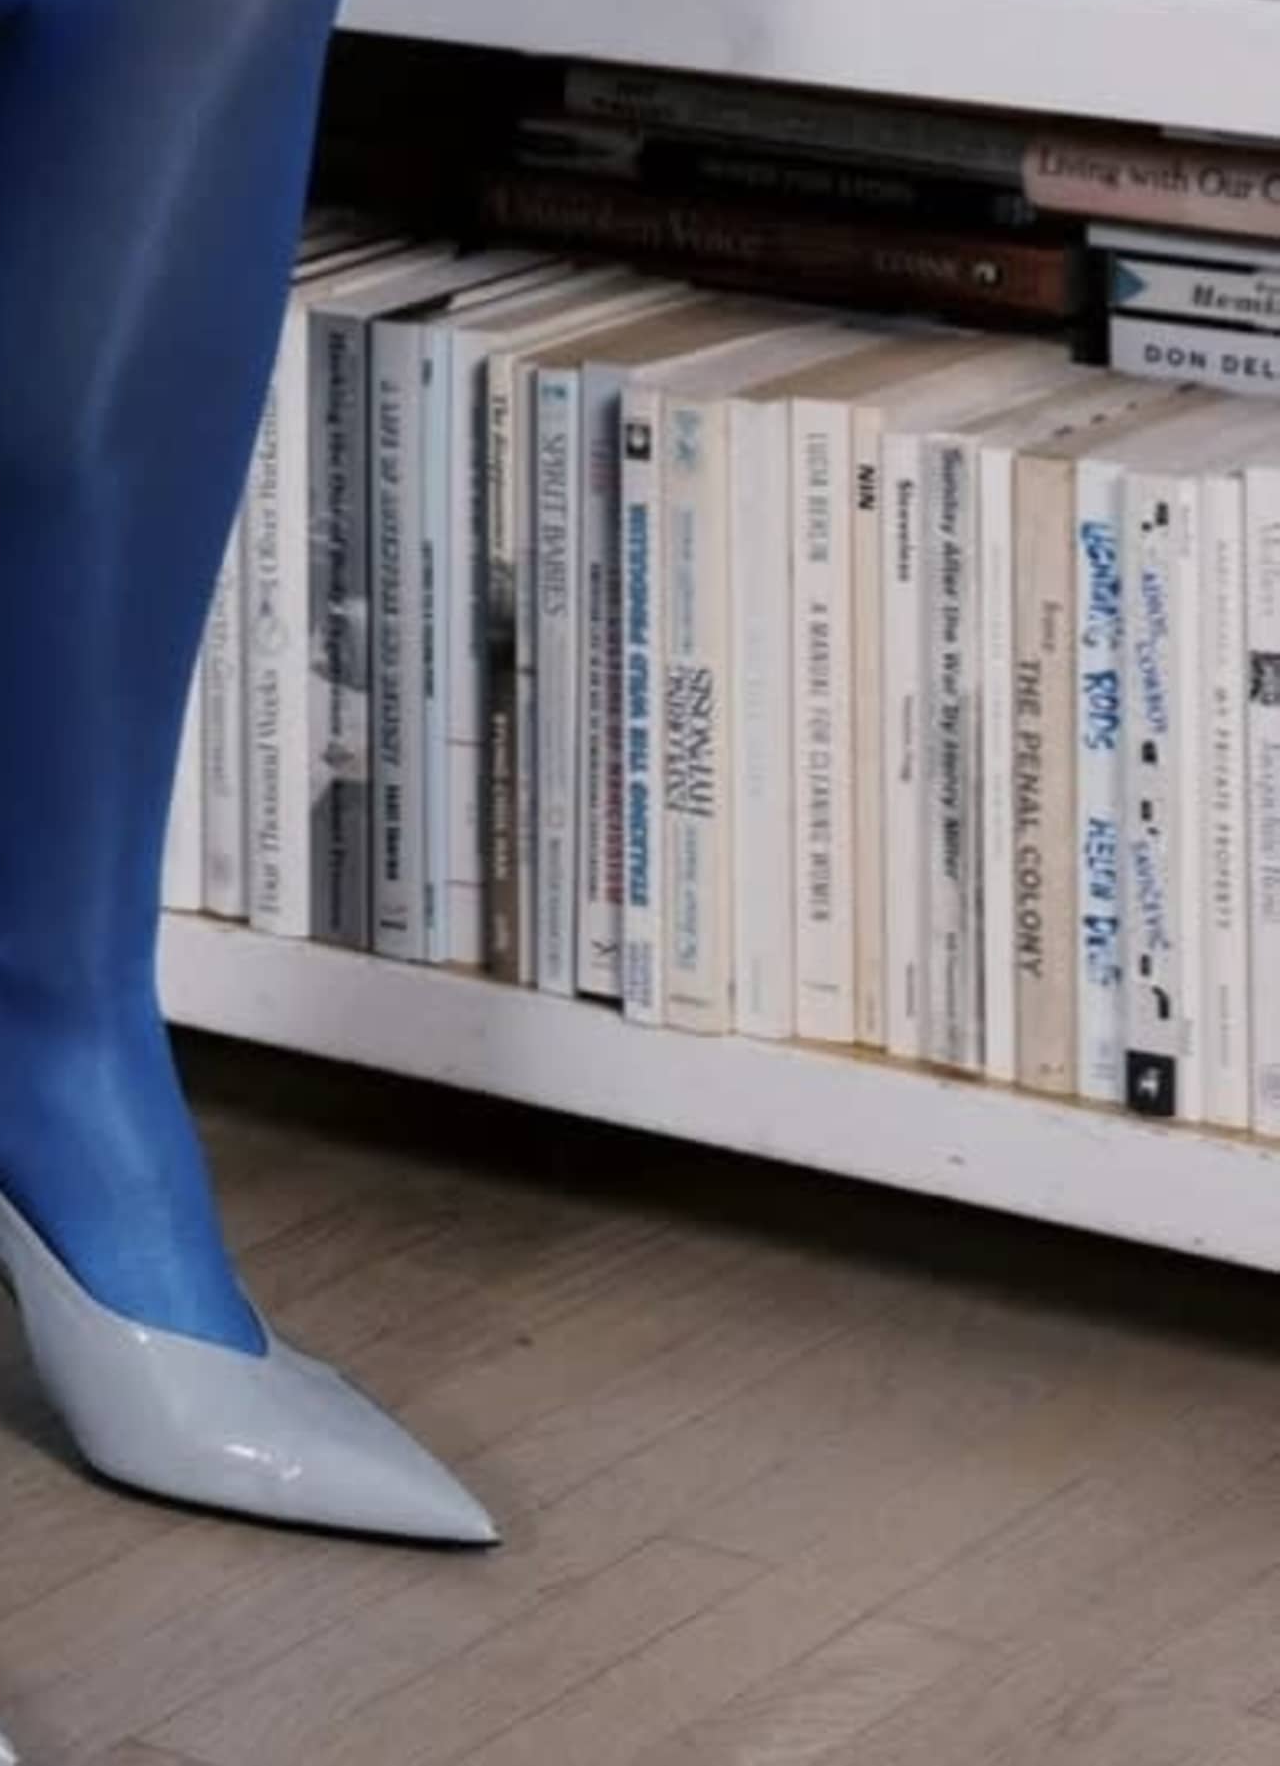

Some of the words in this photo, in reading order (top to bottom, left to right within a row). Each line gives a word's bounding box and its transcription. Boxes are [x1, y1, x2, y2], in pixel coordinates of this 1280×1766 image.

[1144, 343, 1207, 368] DON
[857, 464, 876, 511] NIN
[941, 448, 963, 534] Sunday
[943, 540, 962, 598] After
[943, 605, 960, 643] the
[943, 651, 961, 697] War
[1016, 659, 1041, 718] THE
[1083, 669, 1119, 751] RODS
[942, 740, 960, 808] Henry
[1016, 730, 1042, 833] PENAL
[943, 817, 960, 881] Miller
[1085, 816, 1118, 901] HELEN
[1016, 843, 1043, 980] COLONY
